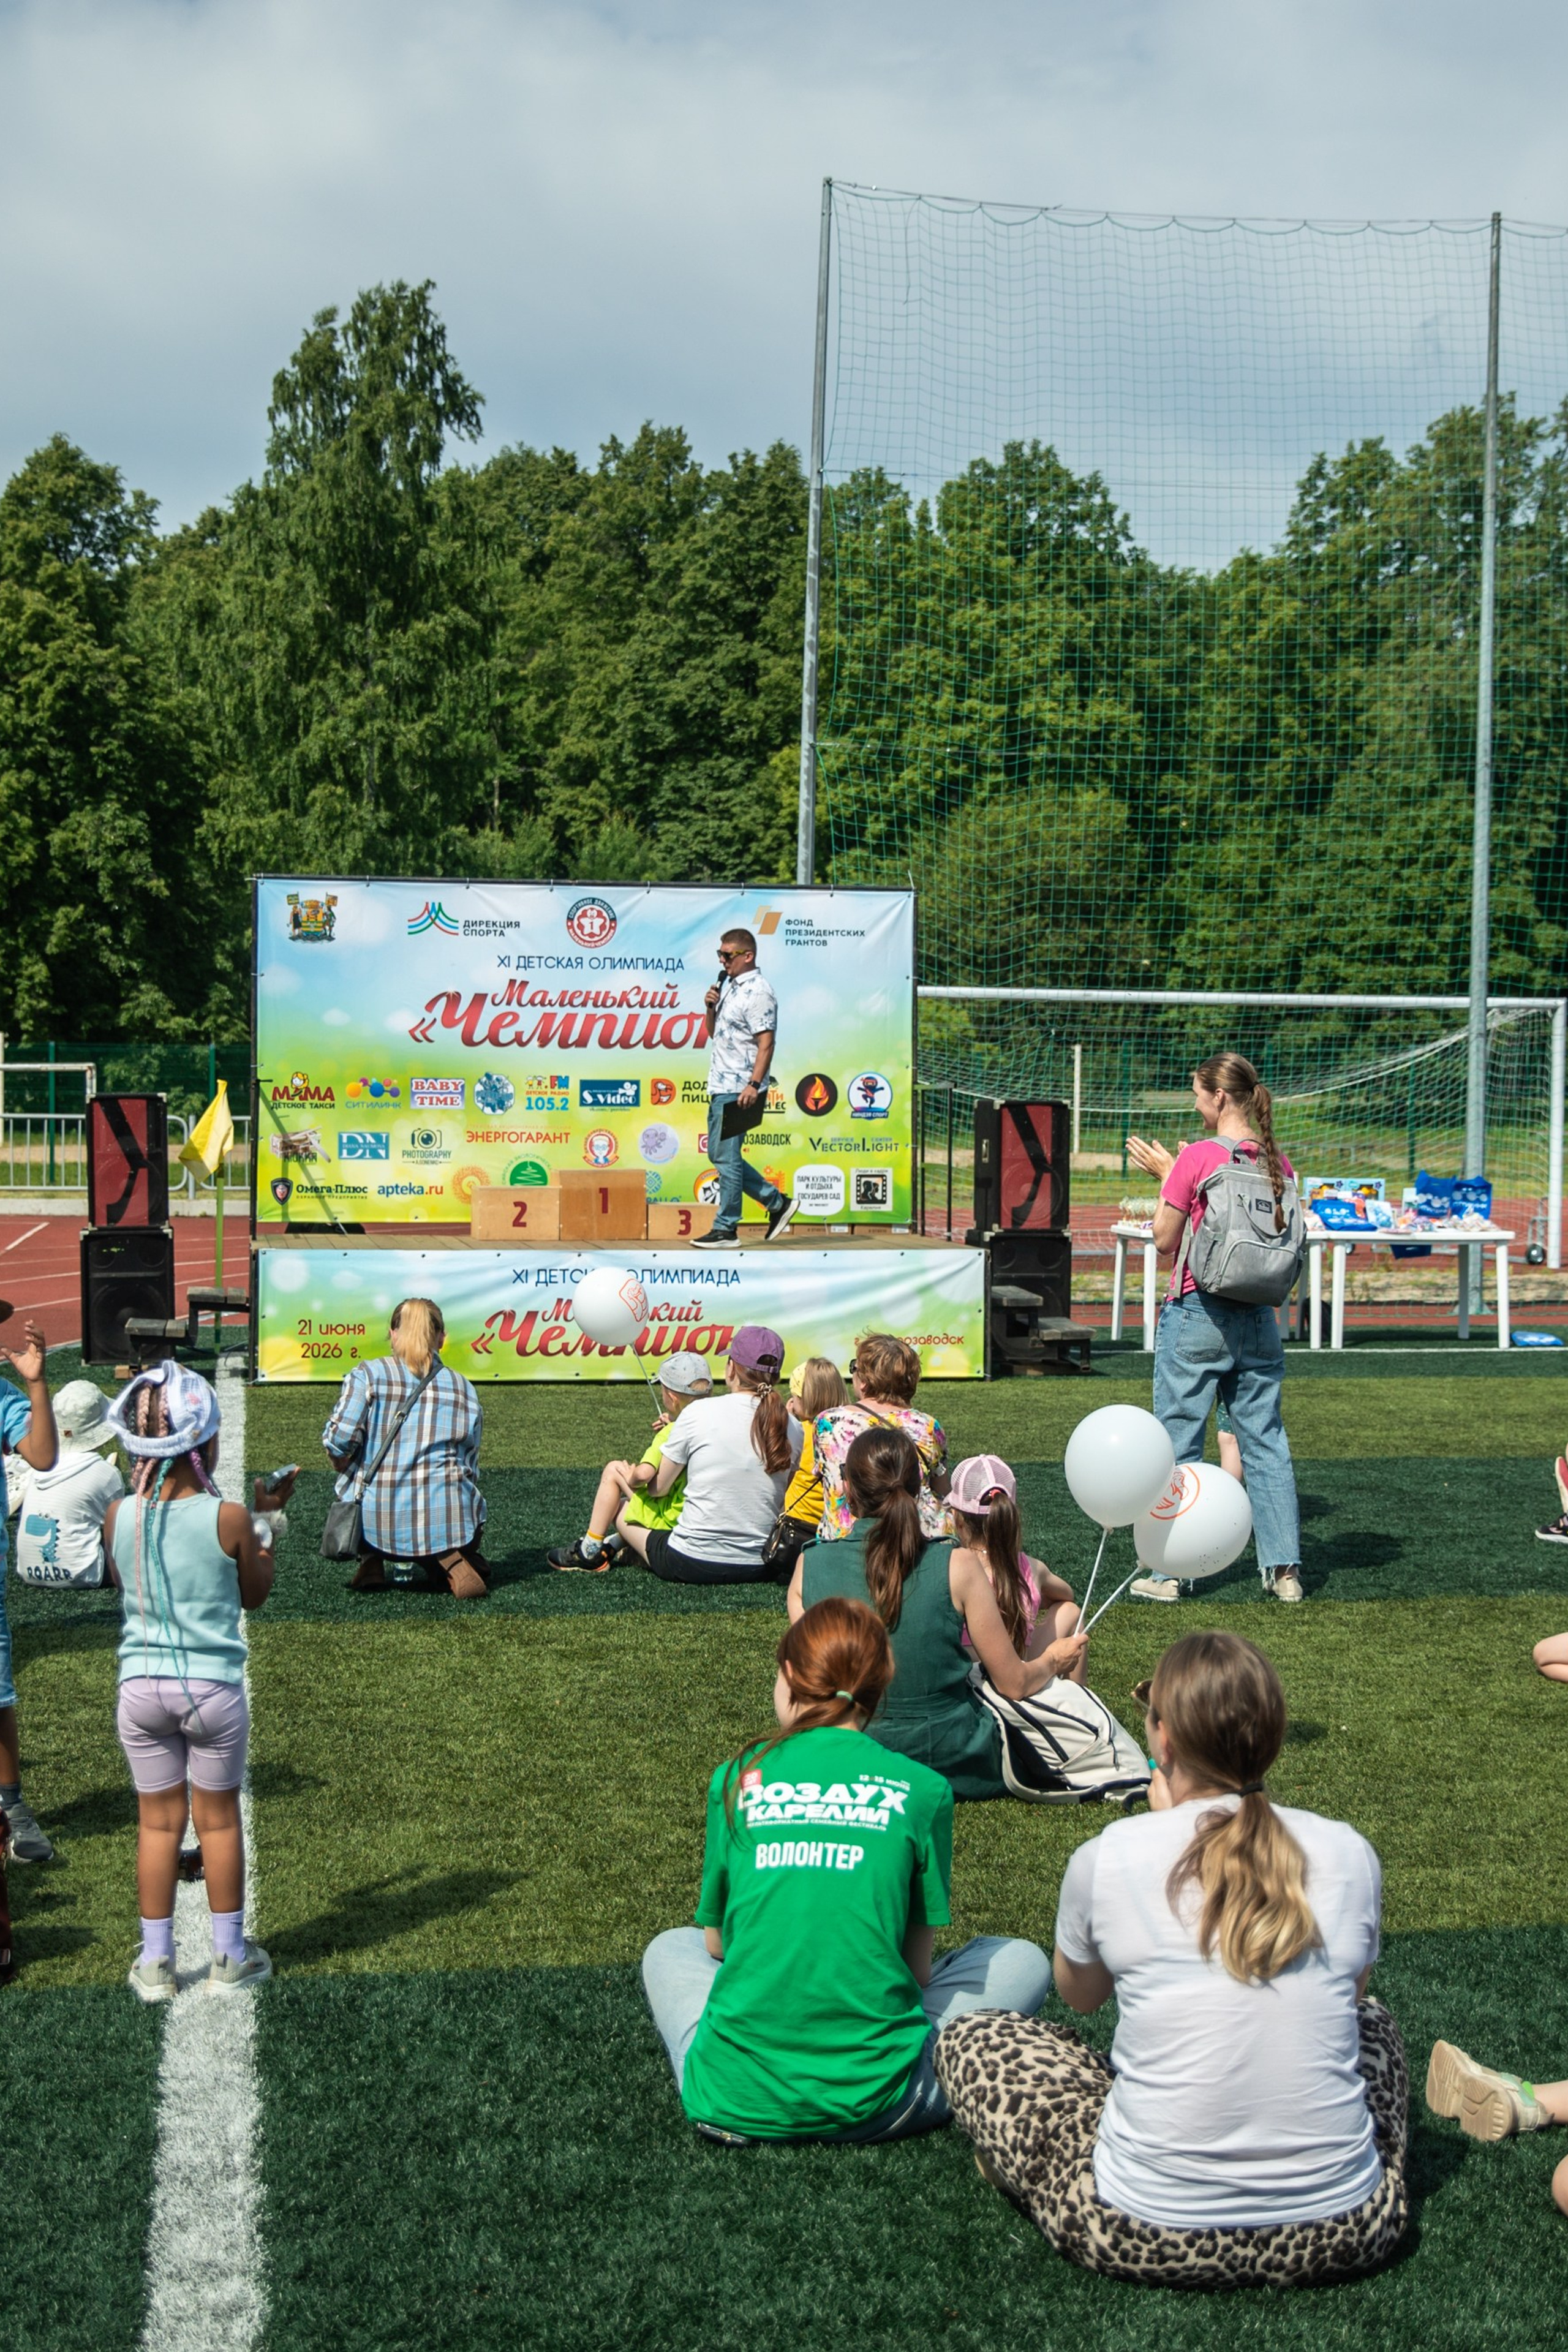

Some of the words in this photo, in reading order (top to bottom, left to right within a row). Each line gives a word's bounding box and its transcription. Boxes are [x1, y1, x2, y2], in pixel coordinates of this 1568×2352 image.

[463, 920, 521, 929] ДИРЕКЦИЯ
[463, 929, 505, 937] СПОРТА
[497, 956, 510, 968] XI
[516, 956, 583, 971] ДЕТСКАЯ
[589, 957, 685, 973] ОЛИМПИАДА
[491, 978, 680, 1009] Маленький
[414, 1080, 463, 1091] BABY
[682, 1081, 707, 1091] ДОД
[271, 1086, 335, 1101] МАМА
[417, 1096, 460, 1106] TIME
[526, 1097, 569, 1110] 105.2
[466, 1131, 571, 1144] ЭНЕРГОГАРАНТ
[339, 1133, 389, 1159] DN
[377, 1183, 443, 1197] apteka.ru
[598, 1187, 608, 1214] 1
[512, 1201, 528, 1227] 2
[677, 1210, 692, 1235] 3
[511, 1269, 528, 1284] XI
[298, 1319, 312, 1336] 21
[318, 1323, 366, 1336] июня
[301, 1343, 343, 1359] 2026
[350, 1348, 362, 1359] г.
[27, 1566, 74, 1581] ROARR
[738, 1782, 908, 1815] ВОЗДУХ
[747, 1803, 890, 1825] КАРЕЛИИ
[848, 1821, 887, 1831] ФЕСТИВАЛЬ
[755, 1841, 864, 1871] ВОЛОНТЕР
